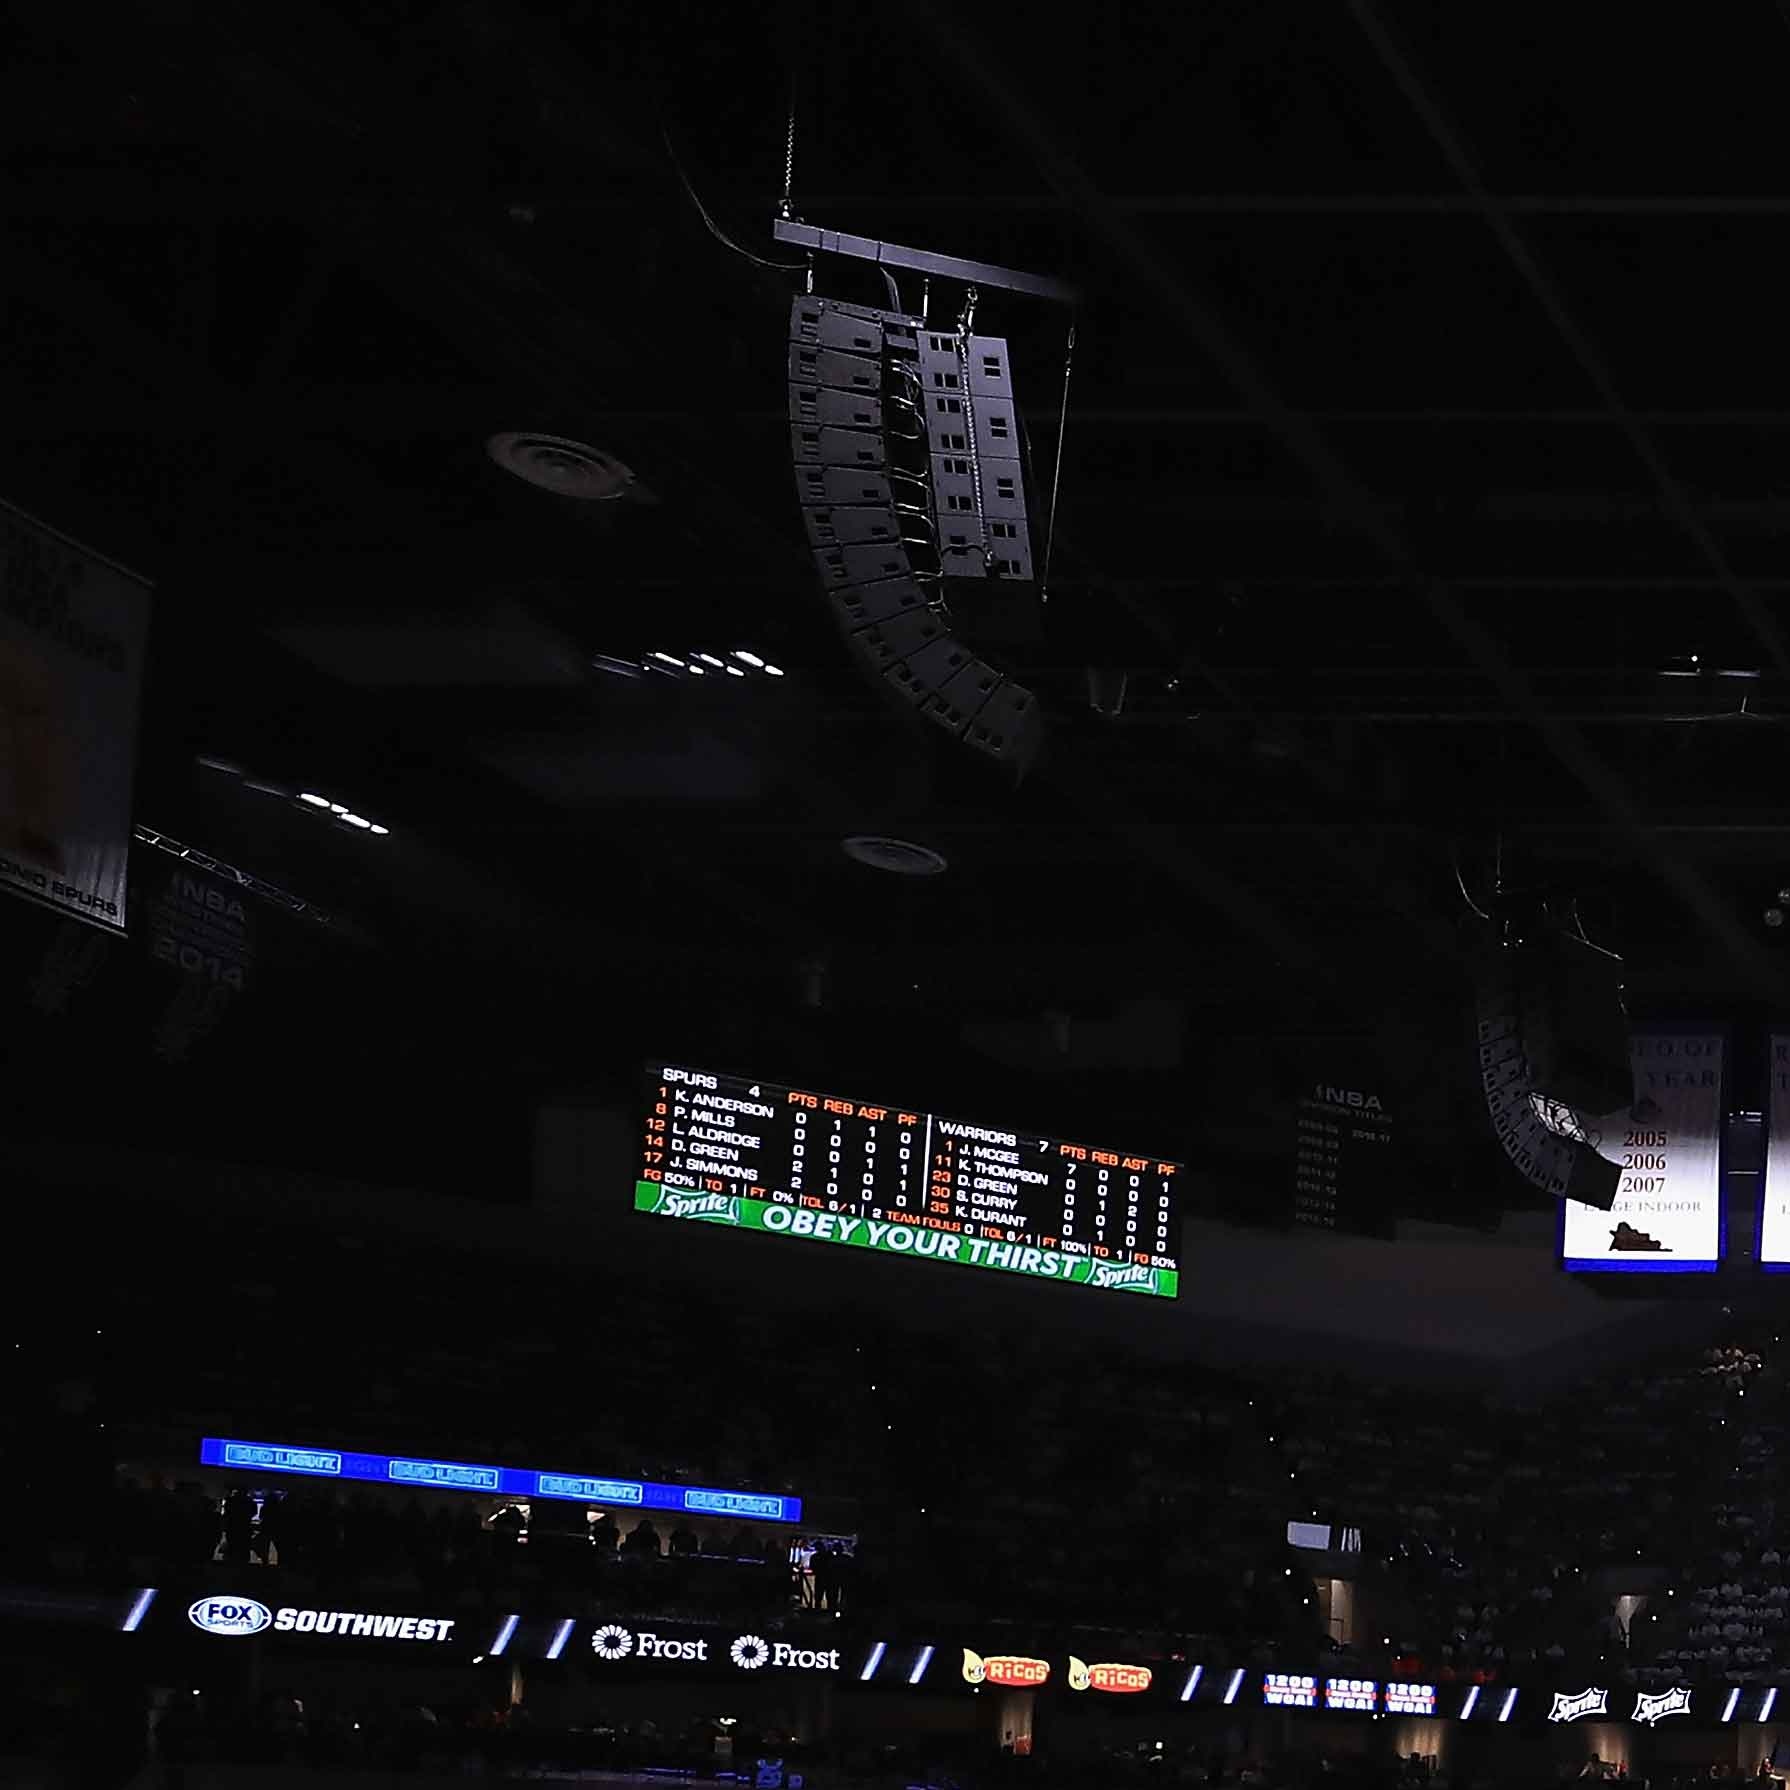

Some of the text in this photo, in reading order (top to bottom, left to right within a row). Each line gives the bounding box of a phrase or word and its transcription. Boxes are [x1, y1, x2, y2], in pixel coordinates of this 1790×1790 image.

[662, 1068, 717, 1090] SPURS
[938, 1121, 1017, 1147] WARRIORS
[1622, 1130, 1668, 1148] 2005
[1622, 1153, 1667, 1172] 2006
[1622, 1175, 1667, 1195] 2007
[762, 1205, 864, 1243] OBEY
[865, 1222, 963, 1261] YOUR
[966, 1240, 1081, 1280] THIRST
[207, 1604, 253, 1622] FOX
[274, 1608, 455, 1641] SOUTHWEST
[636, 1632, 708, 1661] Frost
[772, 1643, 840, 1670] Frost
[1266, 1674, 1314, 1688] 1200
